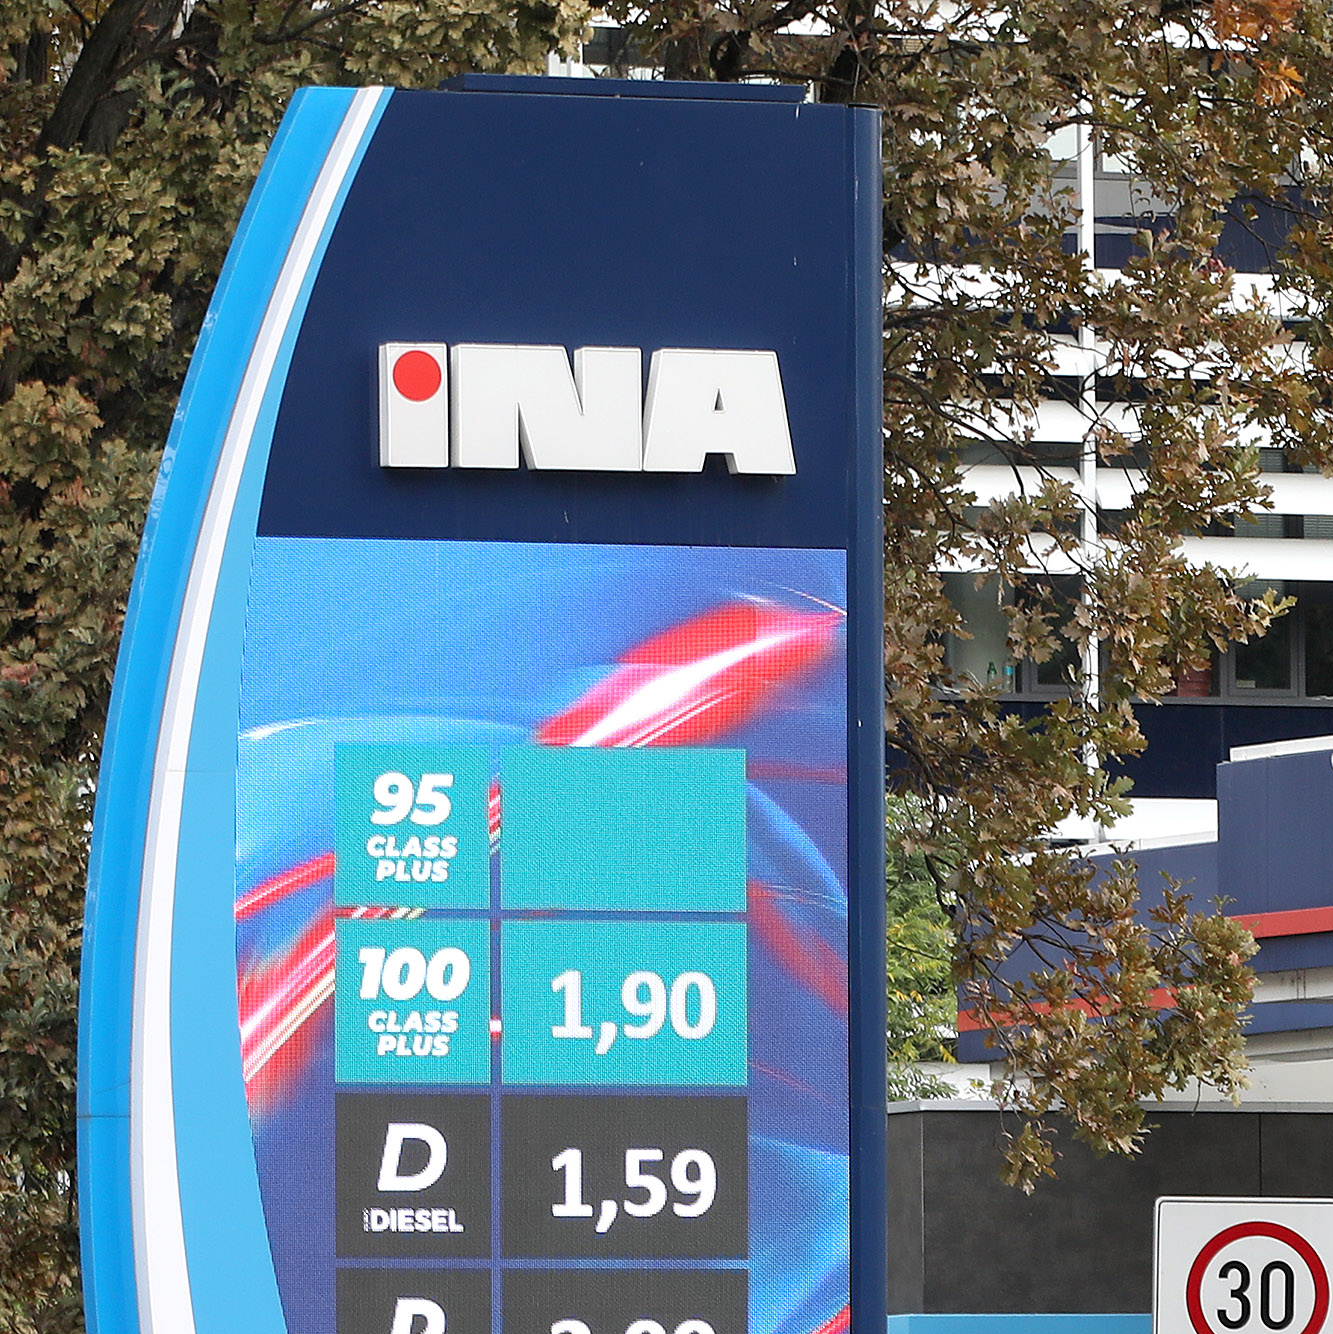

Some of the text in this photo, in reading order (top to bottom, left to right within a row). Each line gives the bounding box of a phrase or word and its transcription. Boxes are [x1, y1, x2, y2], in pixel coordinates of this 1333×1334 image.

[369, 771, 454, 826] 95
[366, 834, 459, 858] CLASS
[376, 859, 449, 882] PLUS
[358, 946, 472, 1001] 100
[368, 1010, 460, 1033] CLASS
[550, 969, 719, 1056] 1,90
[377, 1034, 450, 1056] PLUS
[377, 1122, 449, 1192] D
[550, 1148, 719, 1234] 1,59
[369, 1207, 464, 1232] DIESEL
[1216, 1260, 1295, 1331] 30
